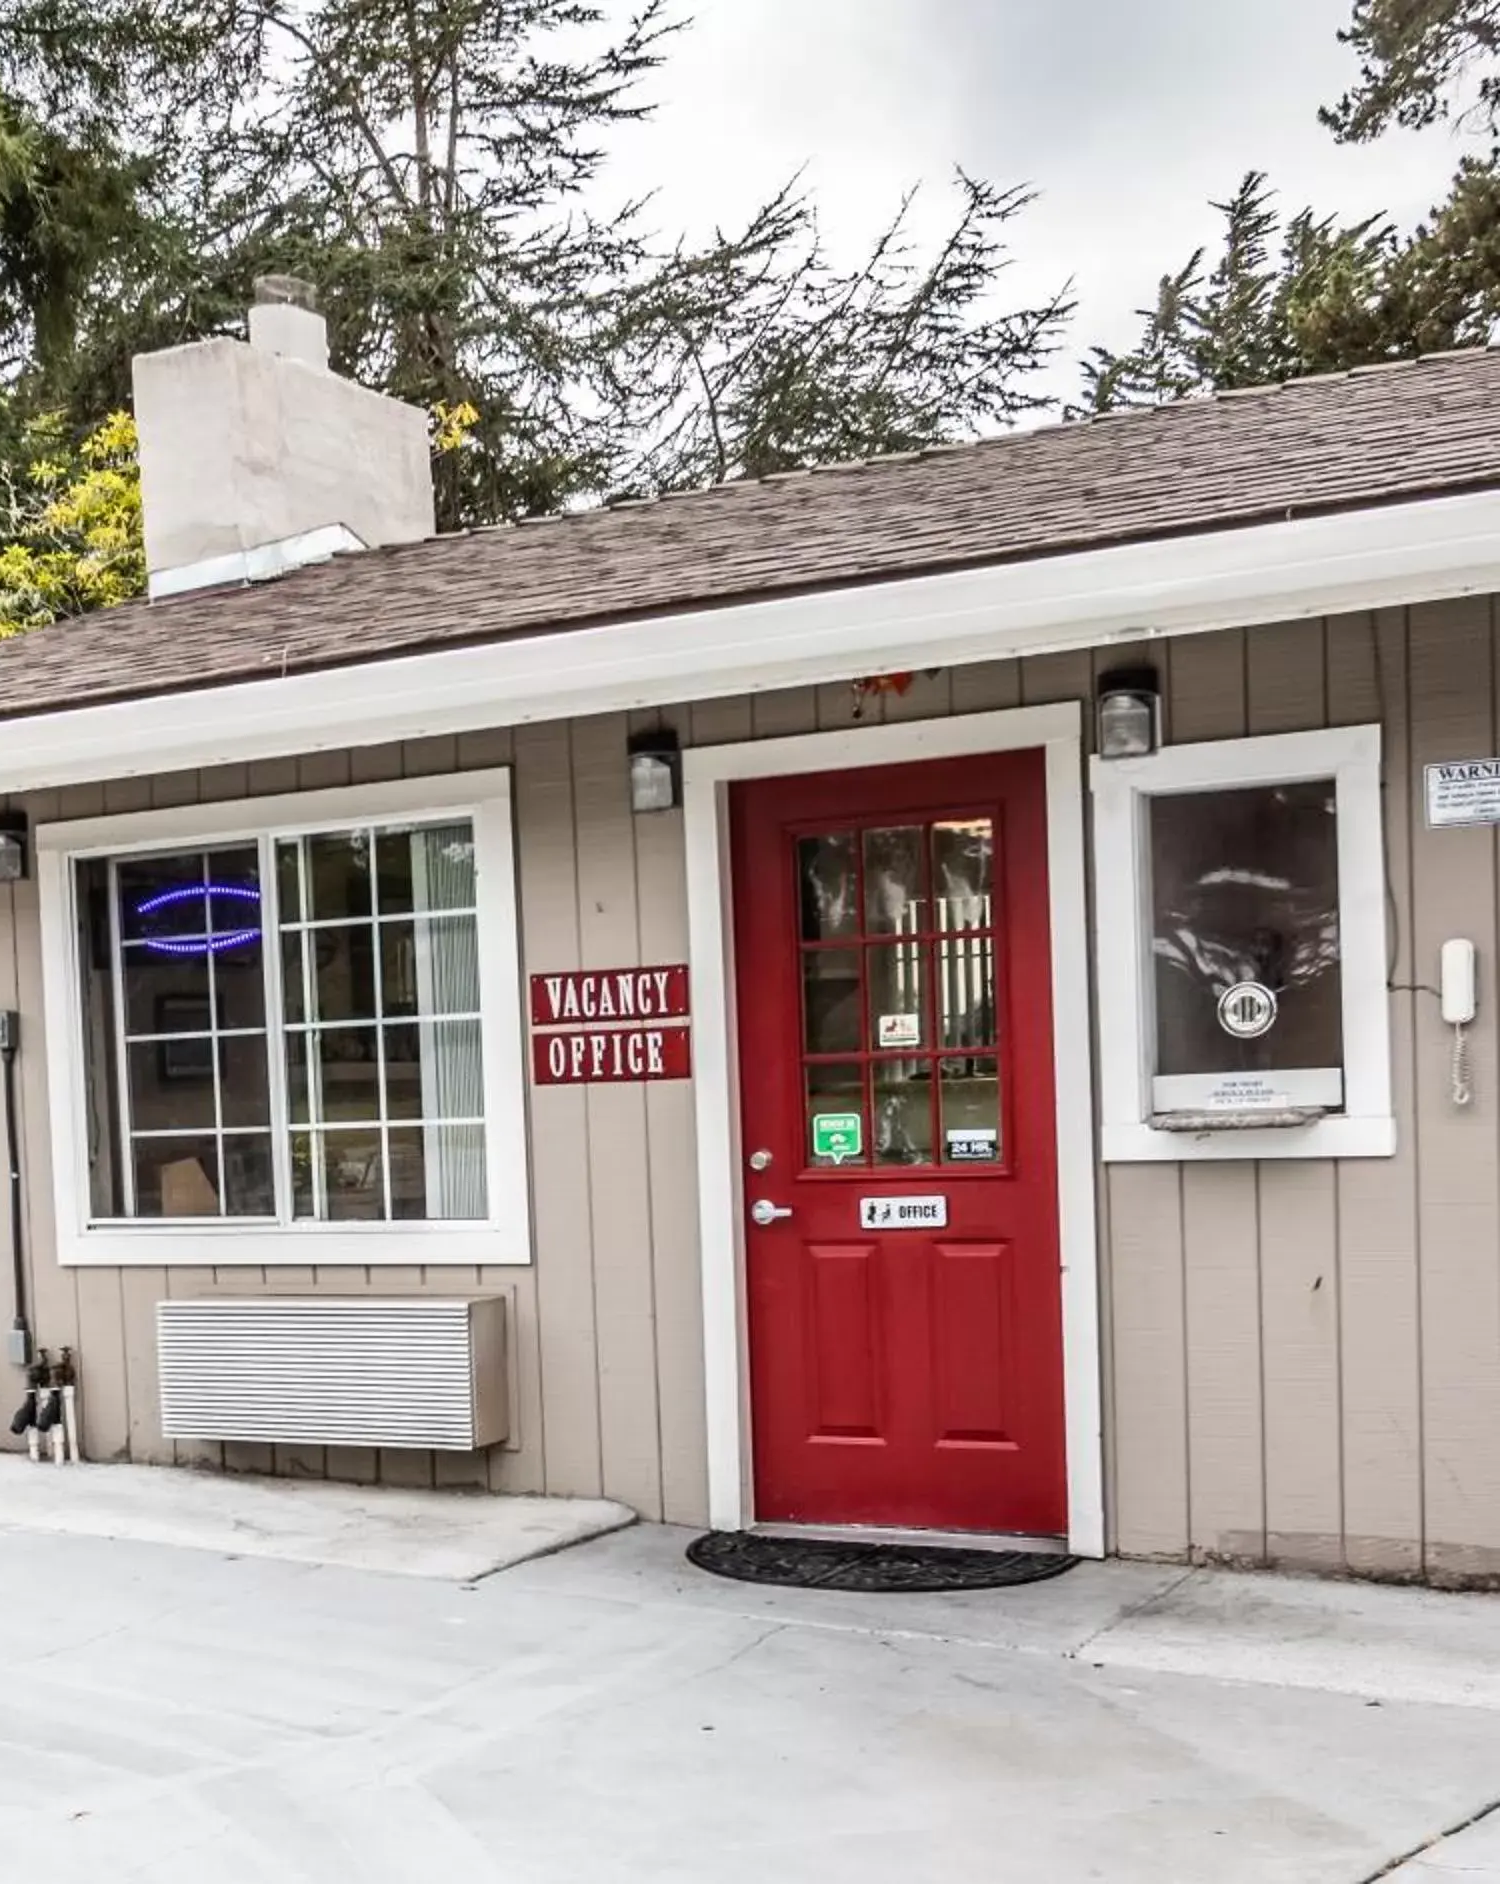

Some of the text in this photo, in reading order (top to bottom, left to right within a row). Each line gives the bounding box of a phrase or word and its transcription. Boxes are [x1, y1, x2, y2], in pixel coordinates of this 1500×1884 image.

[545, 971, 669, 1019] VACANCY
[550, 1031, 665, 1078] OFFICE
[951, 1141, 968, 1153] 24
[899, 1204, 938, 1219] OFFICE
